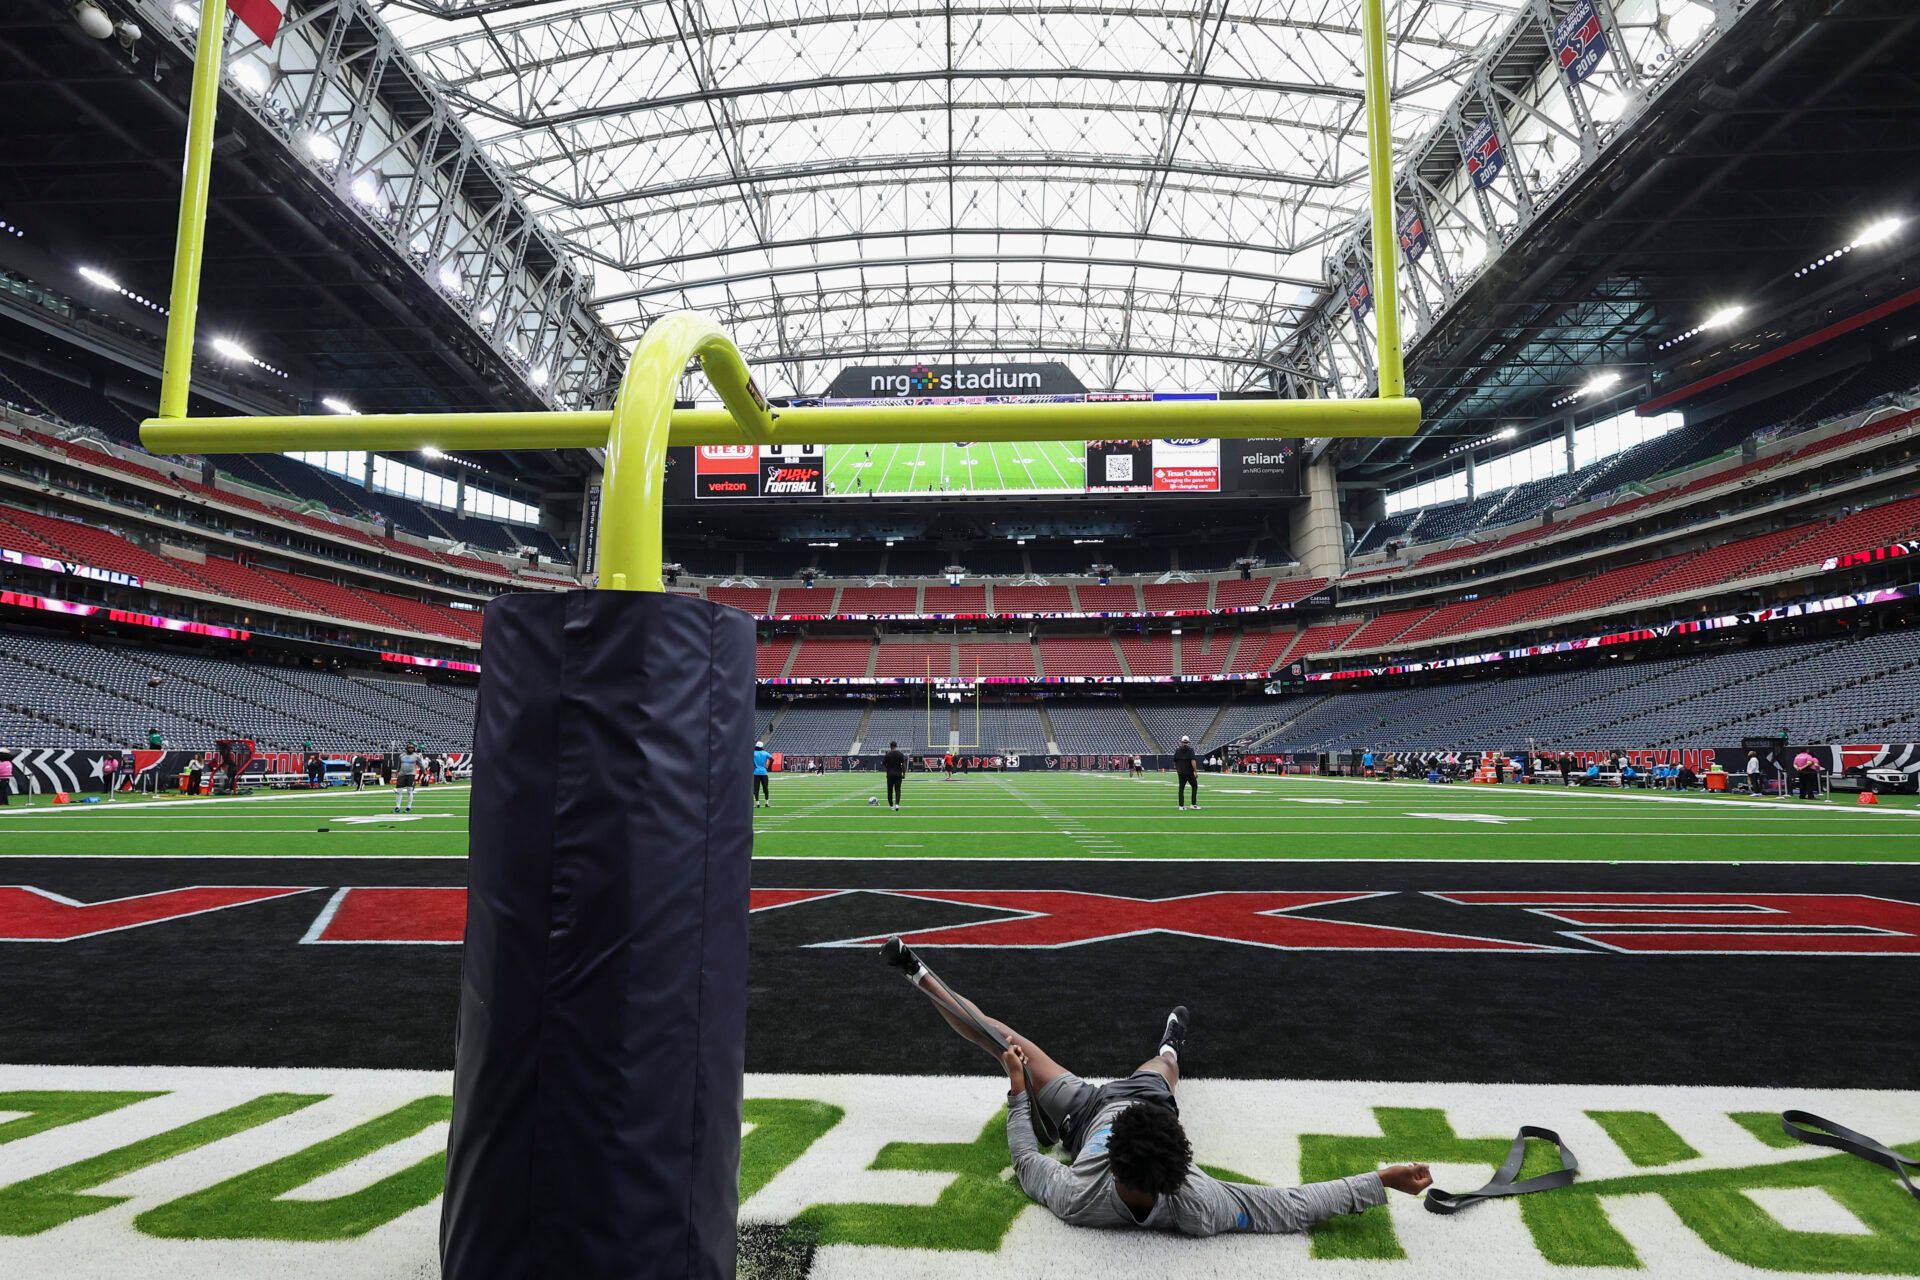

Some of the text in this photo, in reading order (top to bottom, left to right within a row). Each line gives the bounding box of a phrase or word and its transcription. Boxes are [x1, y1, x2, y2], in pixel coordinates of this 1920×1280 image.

[1566, 1, 1584, 24] SOUTH
[1555, 3, 1590, 46] CHAMPIONS
[1575, 49, 1598, 78] 2016
[1479, 161, 1497, 184] 2015
[870, 368, 1041, 396] nrg stadium
[1242, 452, 1285, 464] reliant
[708, 481, 747, 491] verizon
[764, 478, 817, 493] FOOTBALL
[777, 468, 813, 482] PLAY
